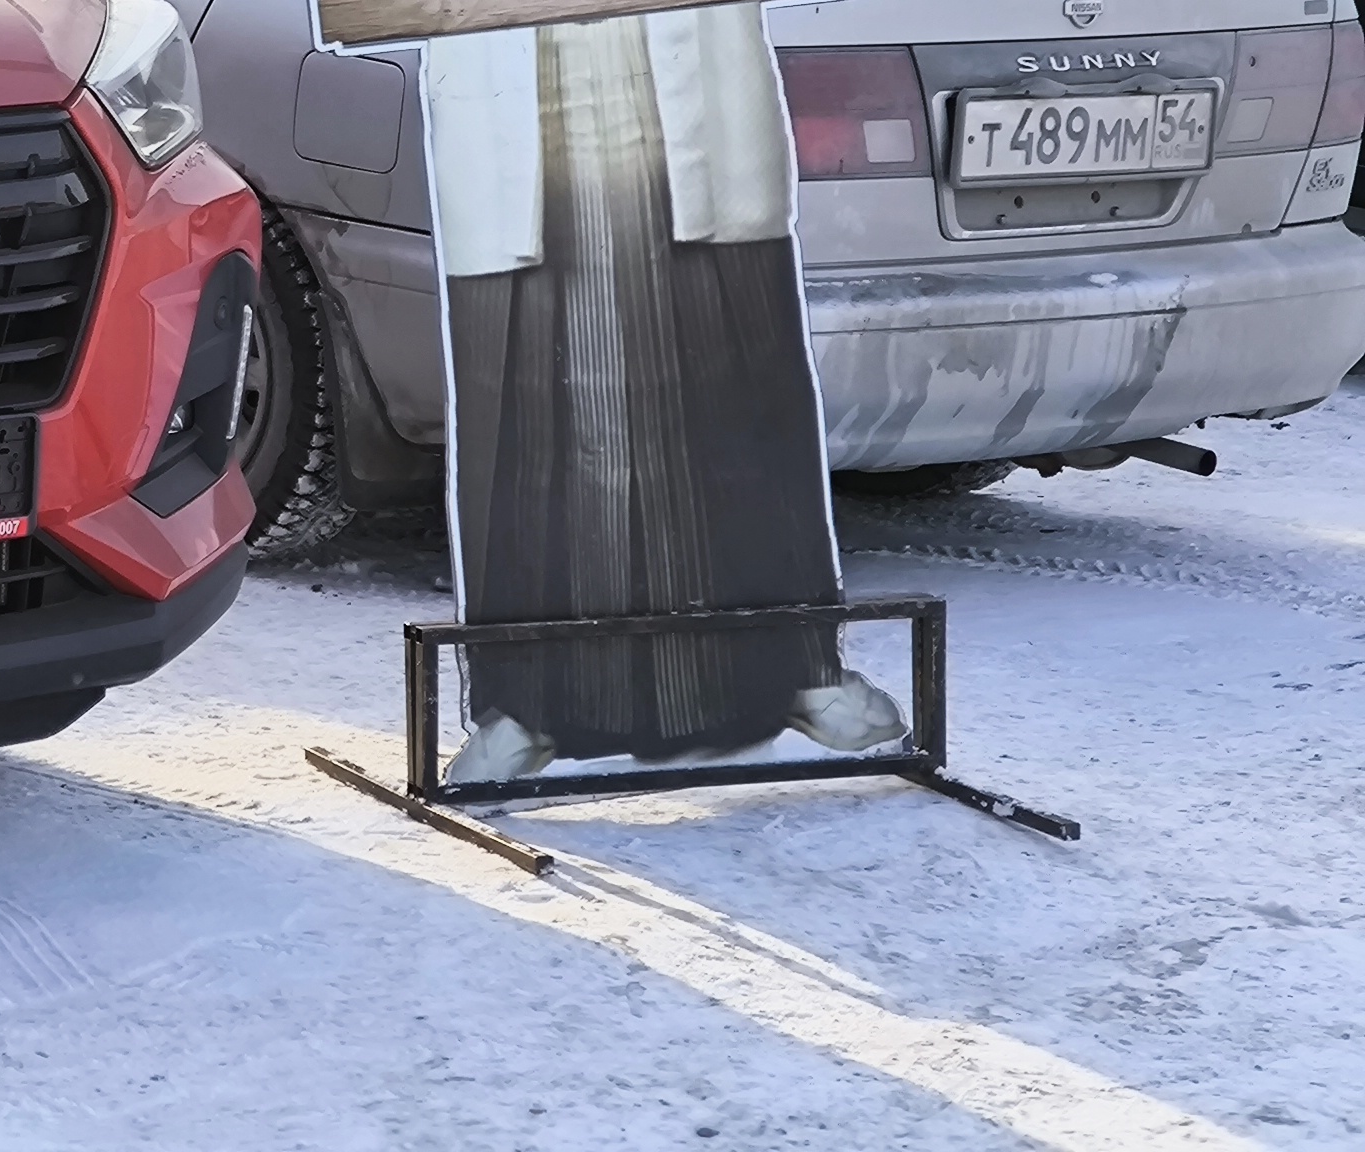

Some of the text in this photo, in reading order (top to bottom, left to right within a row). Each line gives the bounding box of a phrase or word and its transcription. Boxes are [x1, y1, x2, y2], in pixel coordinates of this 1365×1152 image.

[1071, 2, 1102, 13] NISSAN
[1017, 50, 1161, 73] SUNNY
[1158, 98, 1196, 142] 54
[1155, 143, 1182, 159] RUS
